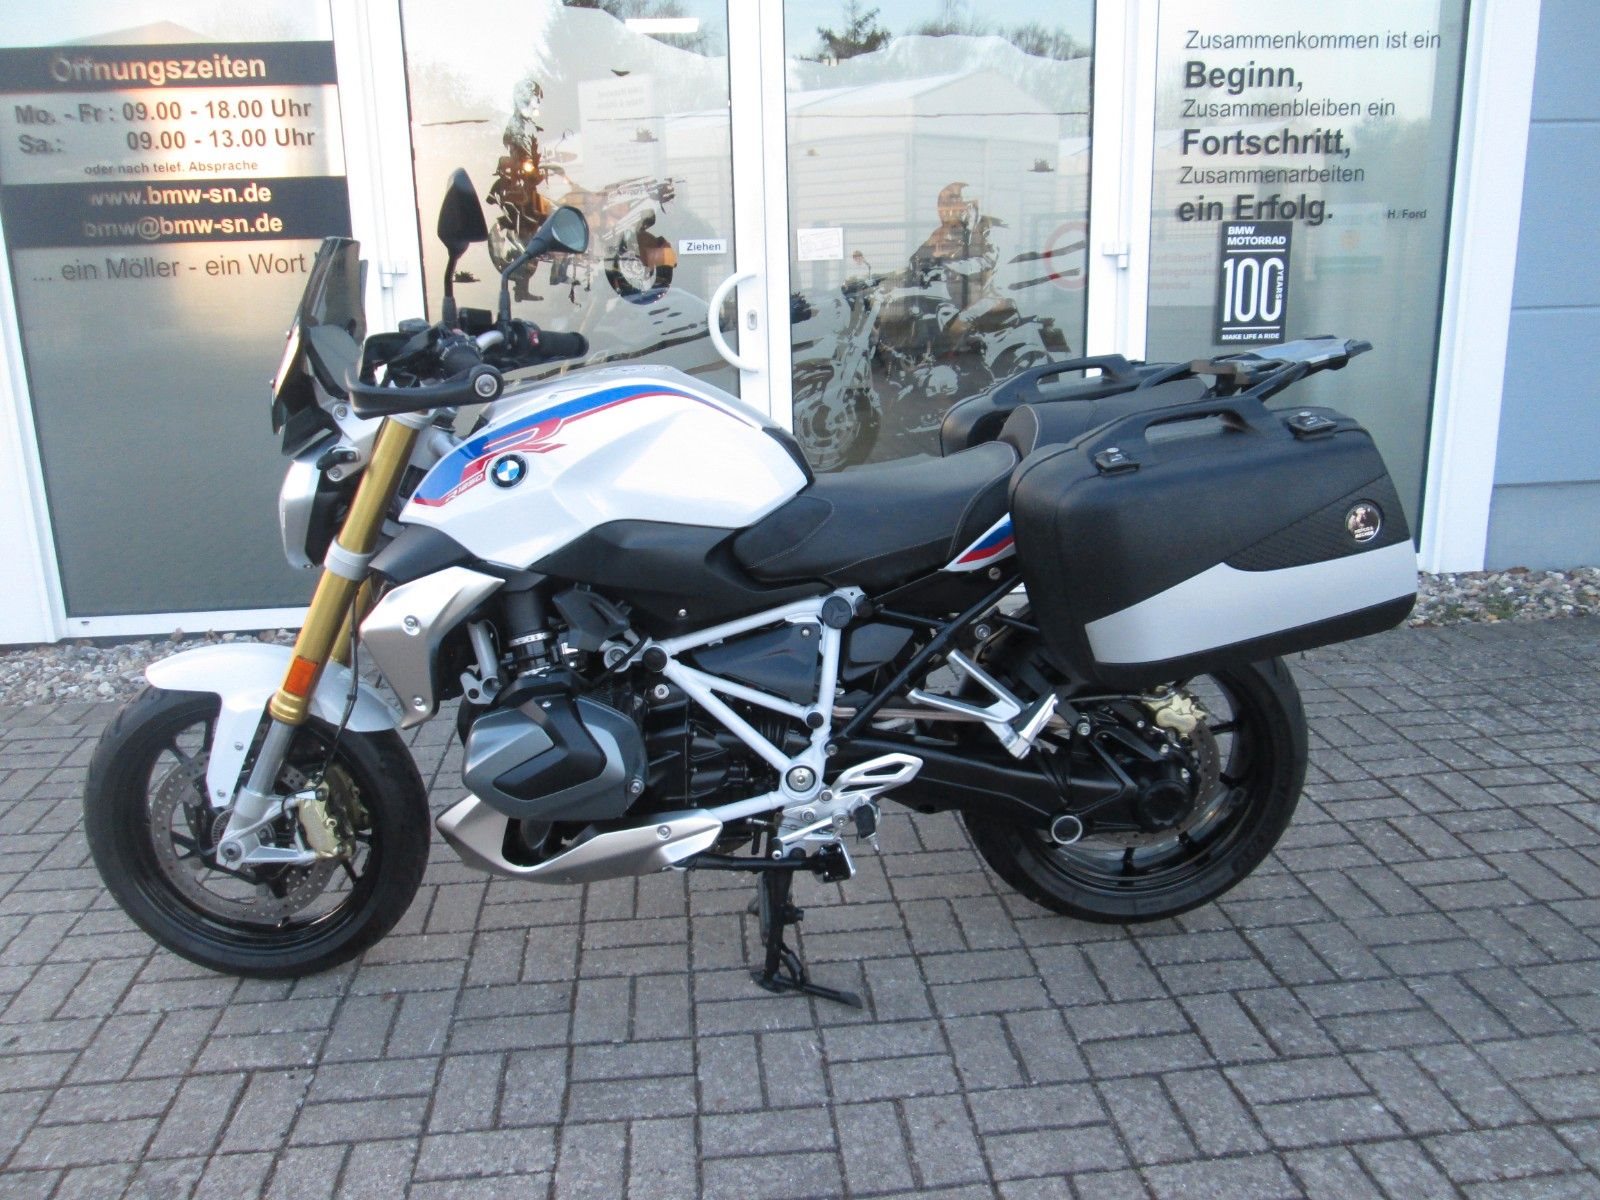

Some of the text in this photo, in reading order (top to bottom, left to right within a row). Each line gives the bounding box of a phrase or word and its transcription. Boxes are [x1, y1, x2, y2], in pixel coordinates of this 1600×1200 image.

[1185, 30, 1441, 49] Zusammenkommen ist ein
[1185, 60, 1303, 95] Beginn,
[15, 105, 56, 126] Mo.
[122, 101, 181, 121] 09.00
[205, 100, 263, 119] 18.00
[271, 100, 312, 118] Uhr
[1183, 98, 1395, 118] Zusammenbleiben ein
[127, 131, 186, 150] 09.00
[208, 129, 266, 148] 13.00
[274, 128, 315, 147] Uhr
[1182, 128, 1351, 157] Fortschritt,
[84, 160, 258, 175] oder nach telef. Absprache
[1179, 166, 1365, 184] Zusammenarbeiten
[91, 182, 272, 206] www.bmw-sn.de
[1178, 194, 1334, 226] ein Erfolg.
[1402, 208, 1427, 219] Ford
[84, 213, 283, 240] bmw@bmw-sn.de
[1228, 226, 1255, 235] BMW
[686, 242, 721, 252] Ziehen
[1227, 236, 1286, 245] MOTORRAD
[62, 260, 97, 280] ein
[105, 257, 180, 279] Möller
[205, 255, 241, 276] ein
[248, 253, 306, 275] Wort
[1223, 257, 1284, 322] 100
[1276, 269, 1284, 299] YEARS
